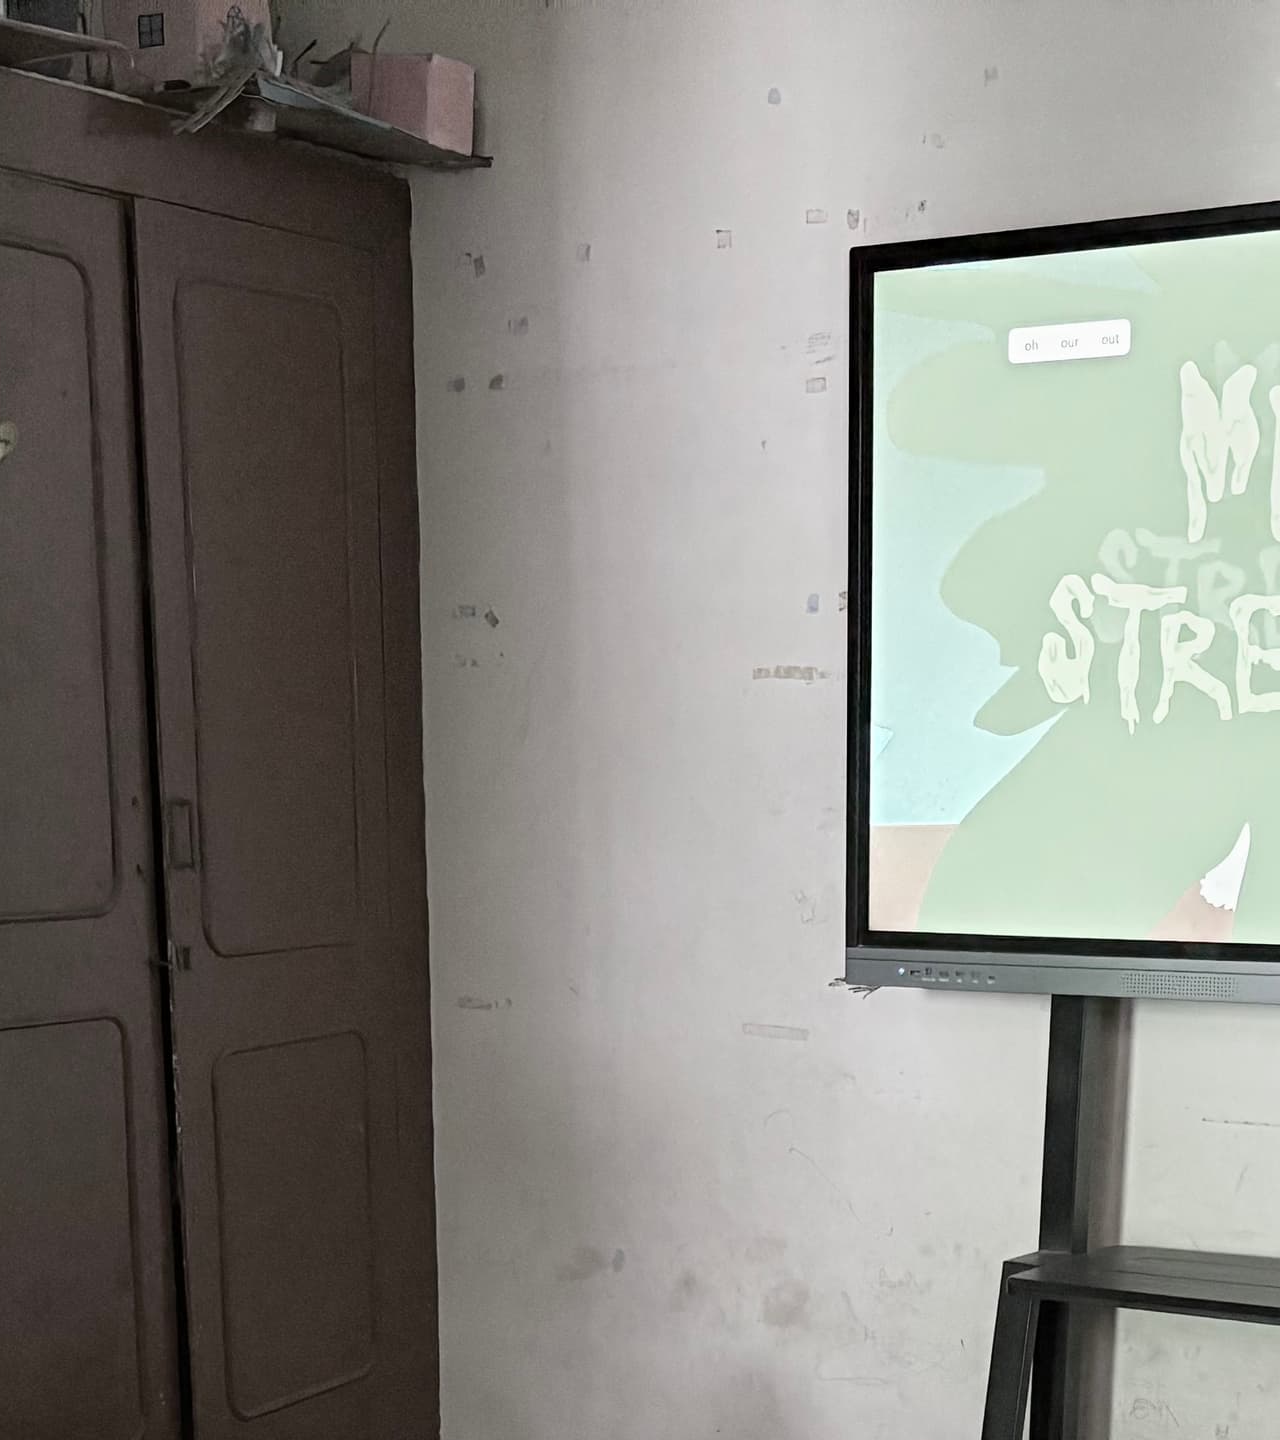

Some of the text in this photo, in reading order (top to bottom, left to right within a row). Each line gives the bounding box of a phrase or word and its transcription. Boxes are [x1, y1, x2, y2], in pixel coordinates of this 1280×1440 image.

[1024, 333, 1120, 351] oh our out
